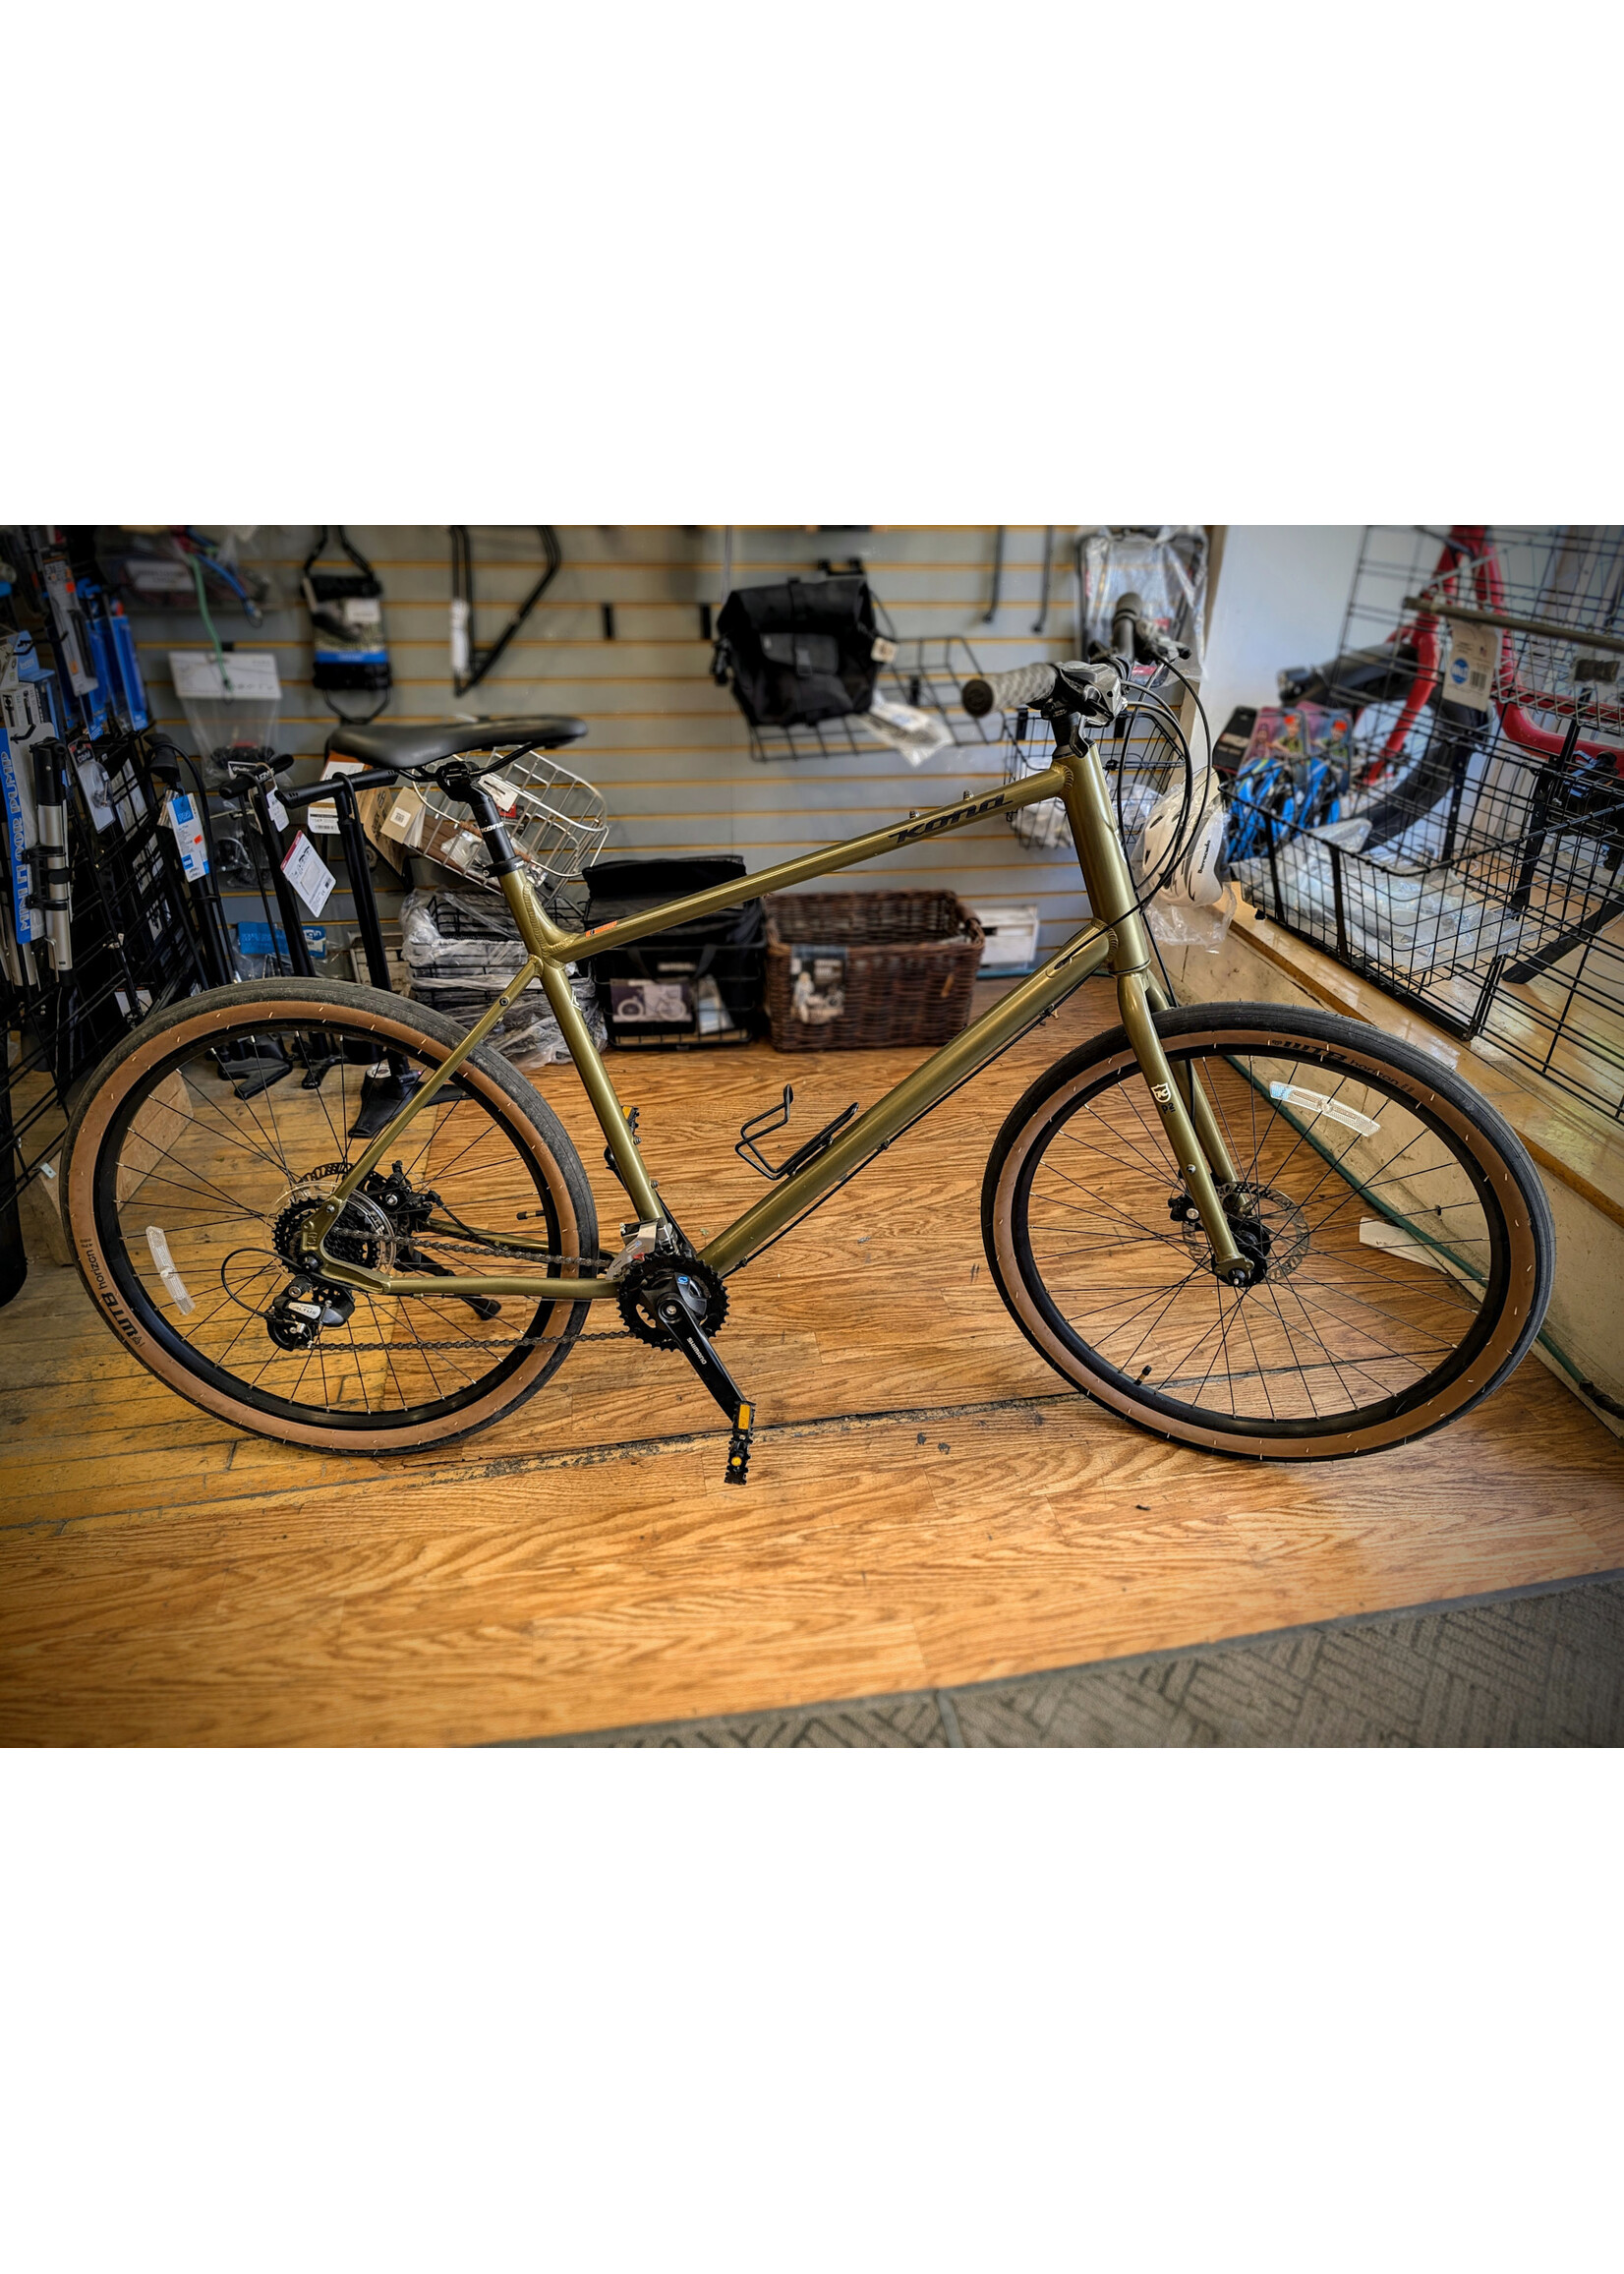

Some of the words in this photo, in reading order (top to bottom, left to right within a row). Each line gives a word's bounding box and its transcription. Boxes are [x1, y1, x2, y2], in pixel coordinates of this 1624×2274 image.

[1, 751, 22, 813] PUMP
[18, 888, 30, 932] MINI
[1350, 1059, 1399, 1085] horizon
[87, 1250, 108, 1290] horizon
[292, 1304, 318, 1315] ALTUS
[687, 1337, 708, 1365] SHIMANO
